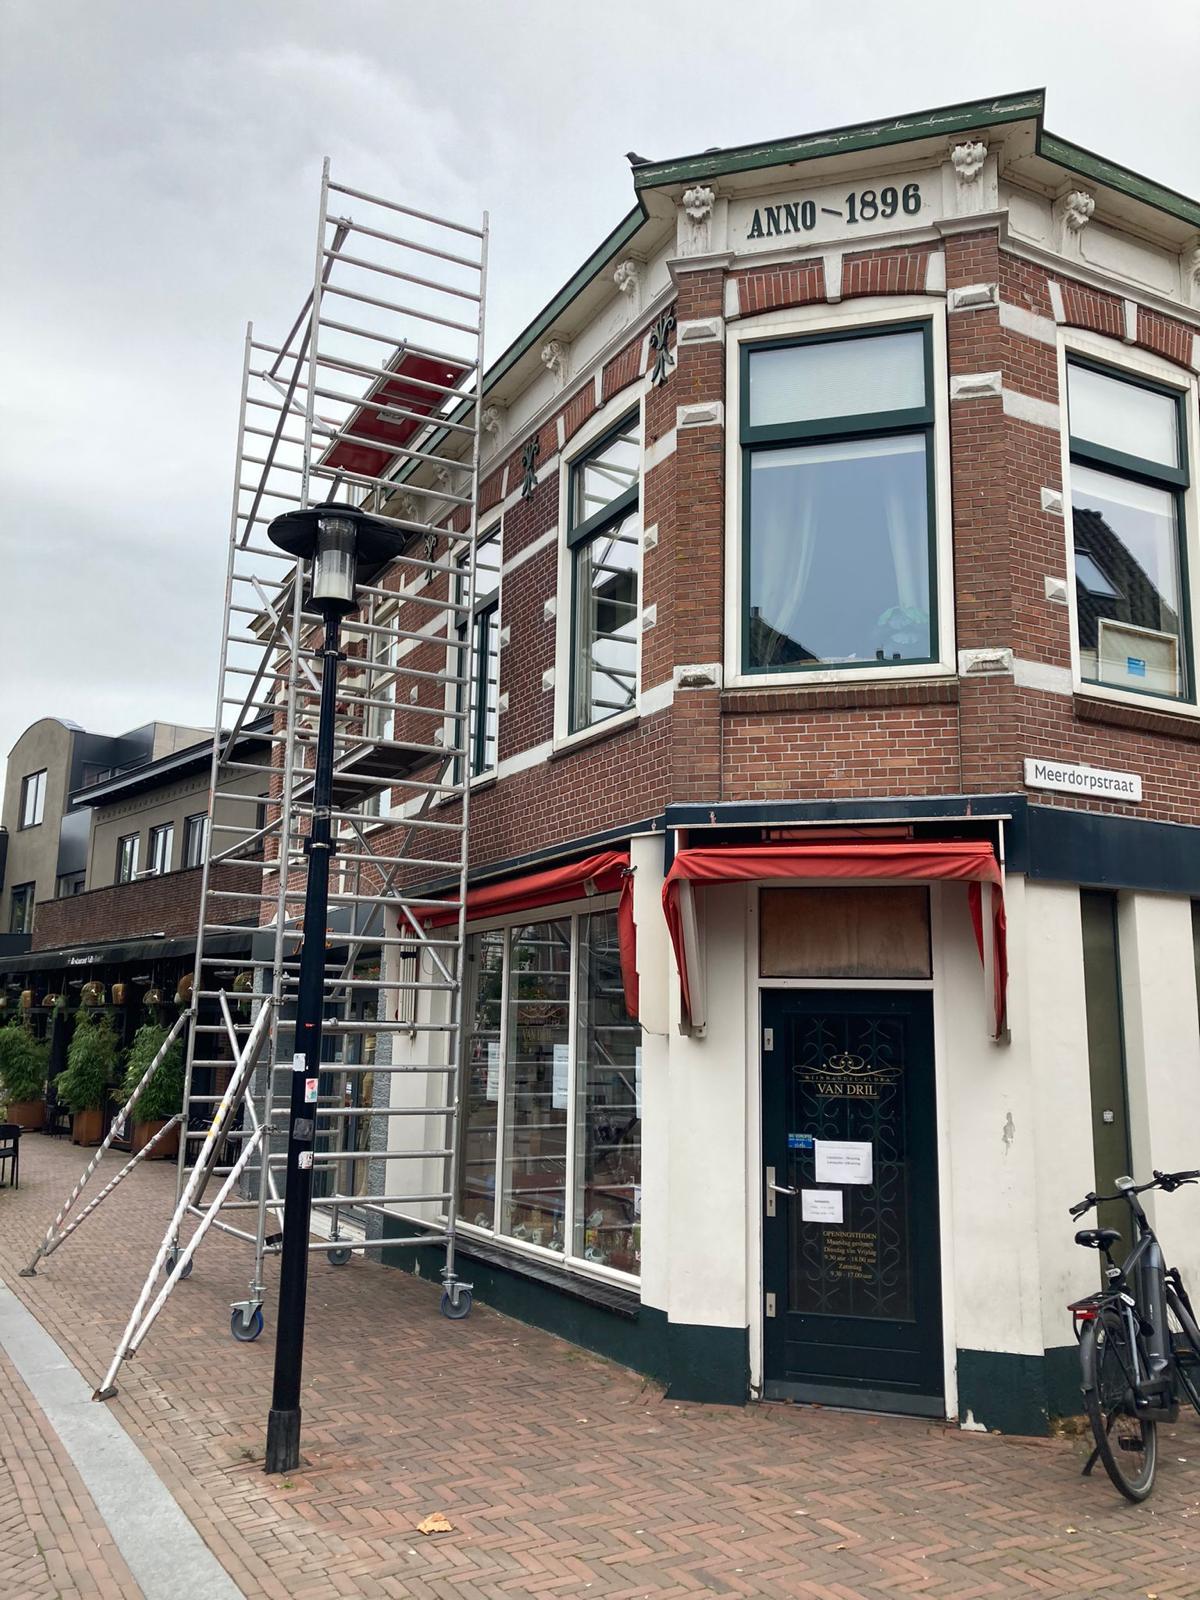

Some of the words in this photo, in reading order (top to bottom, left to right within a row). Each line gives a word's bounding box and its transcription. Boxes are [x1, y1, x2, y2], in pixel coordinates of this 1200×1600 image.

[747, 200, 816, 239] ANNO
[845, 183, 922, 224] 1896
[1035, 764, 1134, 793] Meerdorpstraat
[817, 1083, 844, 1095] VAN
[846, 1084, 878, 1096] DRIL
